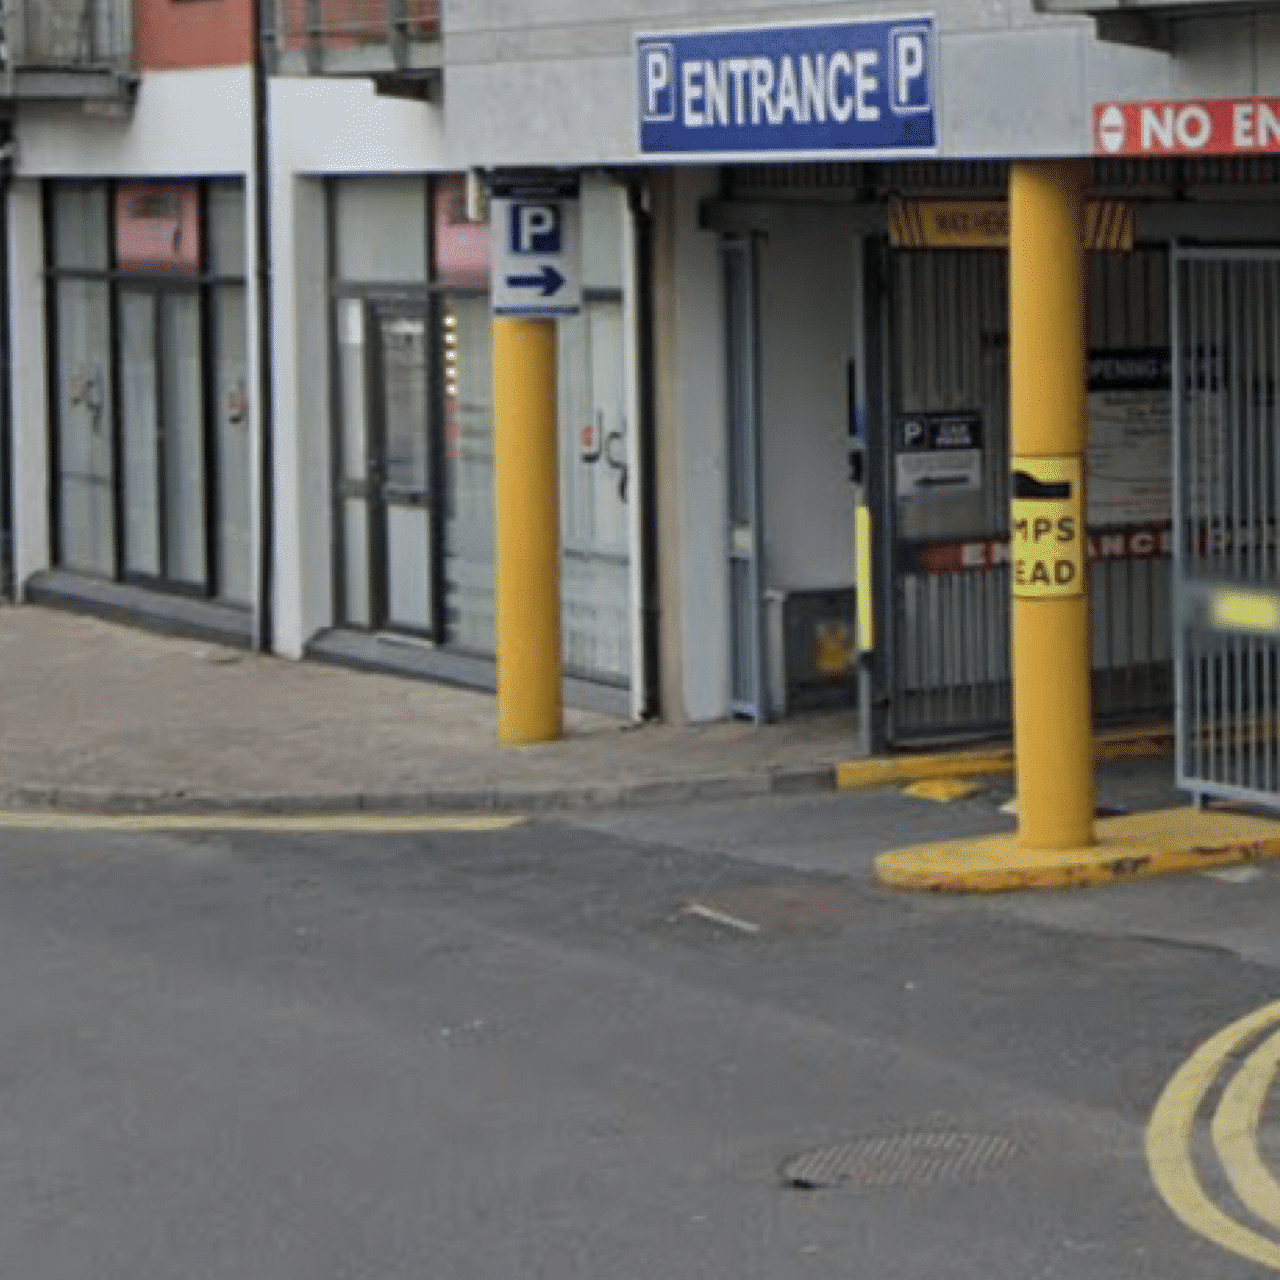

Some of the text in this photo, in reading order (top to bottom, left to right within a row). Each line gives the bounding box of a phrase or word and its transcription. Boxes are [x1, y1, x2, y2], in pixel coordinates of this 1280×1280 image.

[648, 35, 924, 128] P ENTRANCE P
[1140, 105, 1212, 150] NO
[520, 206, 553, 250] P
